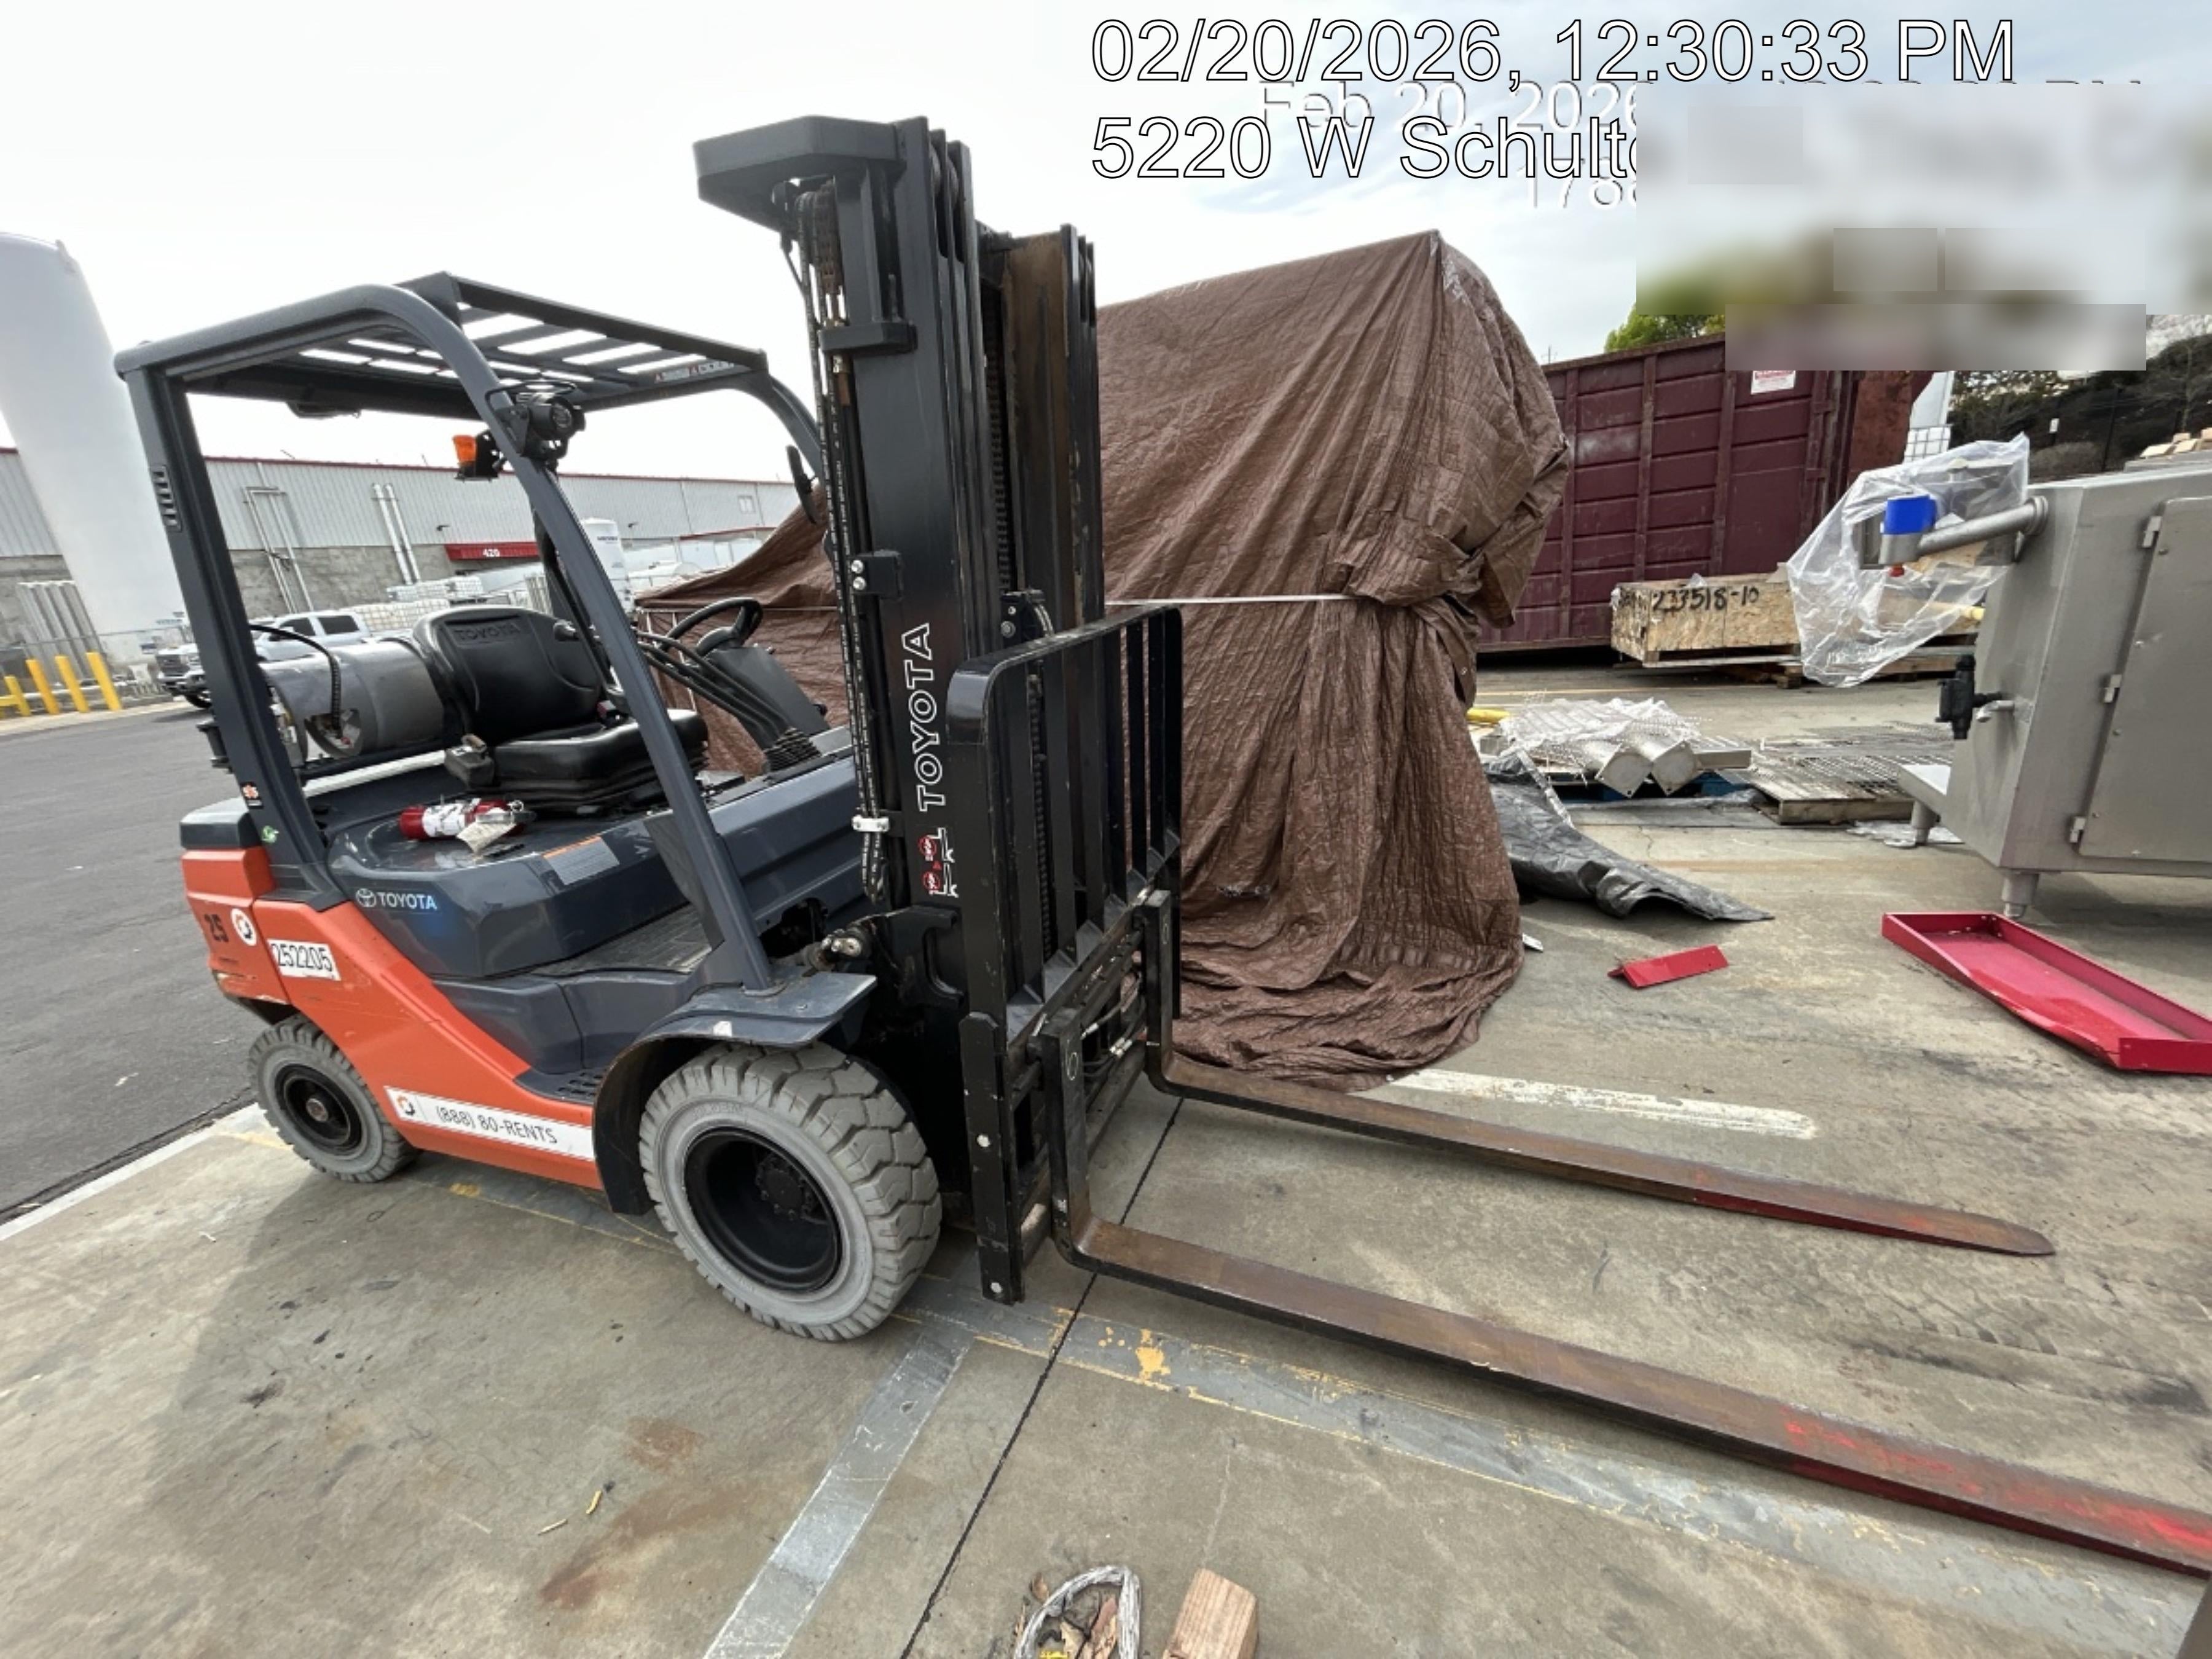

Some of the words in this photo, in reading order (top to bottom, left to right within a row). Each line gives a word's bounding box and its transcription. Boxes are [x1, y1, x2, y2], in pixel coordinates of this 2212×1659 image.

[453, 621, 521, 640] TOYOTA
[901, 622, 946, 812] TOYOTA
[377, 892, 437, 911] TOYOTA
[204, 914, 229, 943] 25
[270, 943, 333, 972] 252205
[436, 1105, 476, 1129] (888)
[477, 1114, 557, 1144] 80-RENTS
